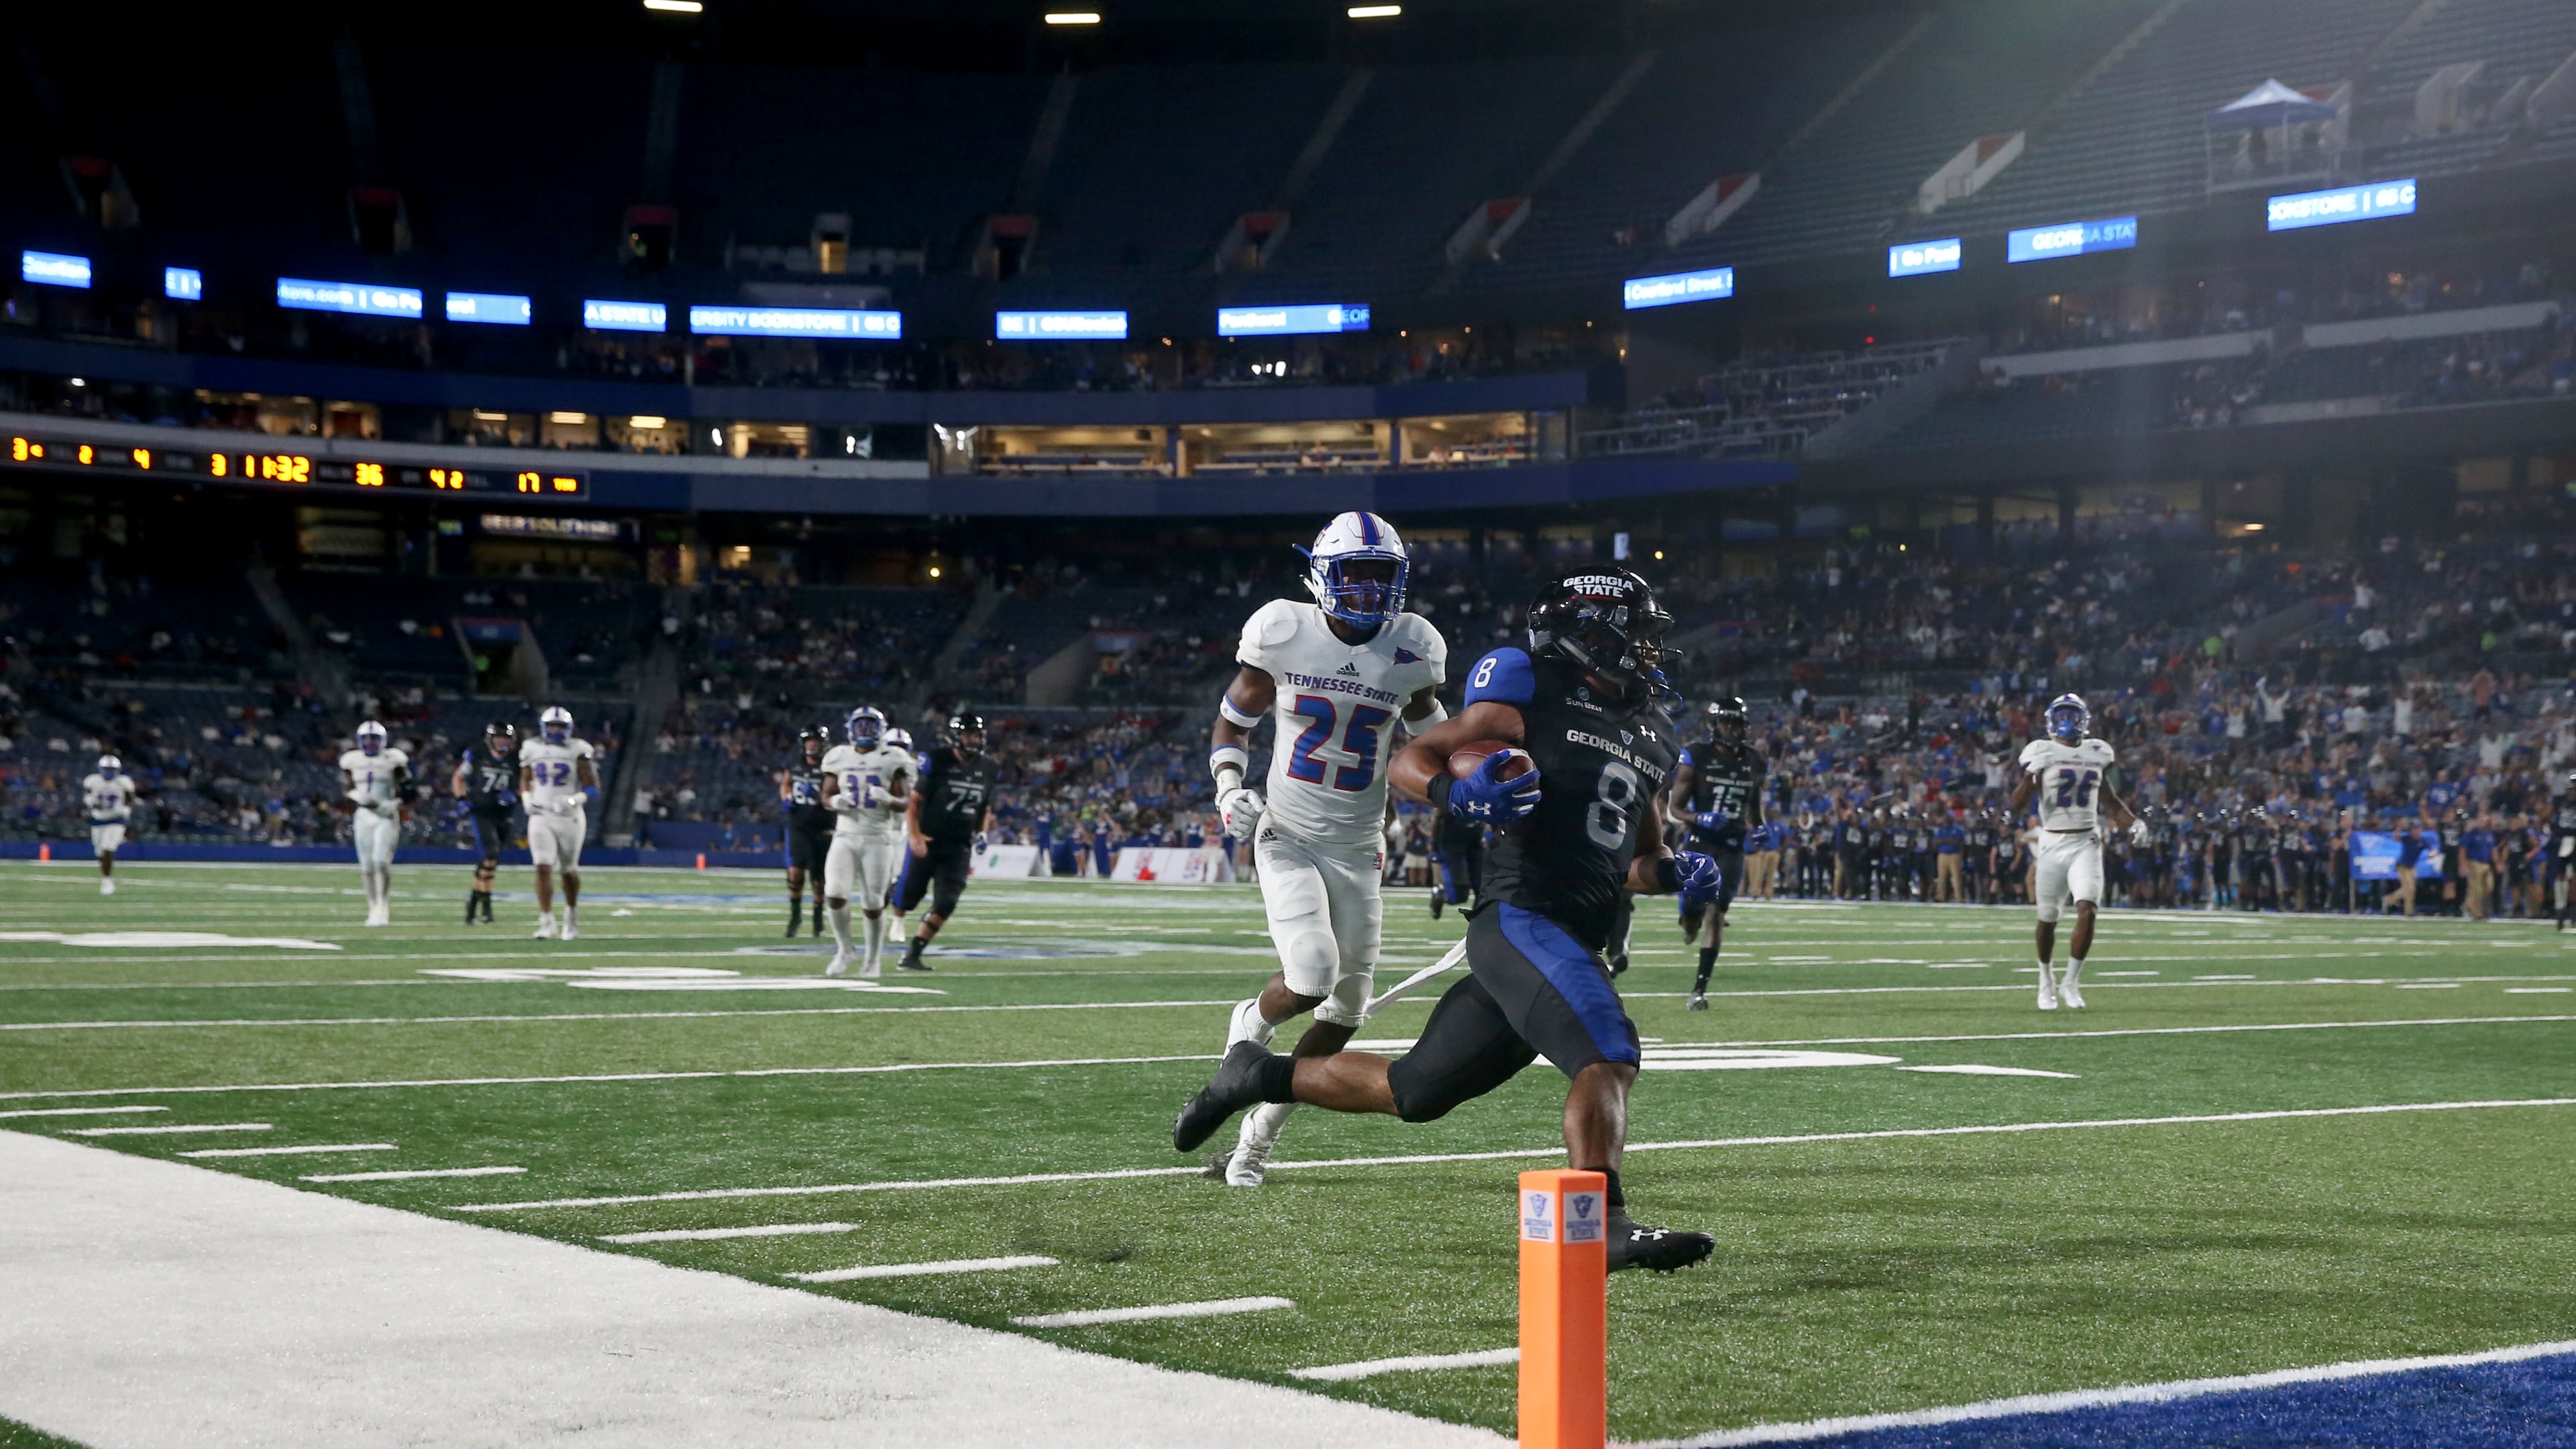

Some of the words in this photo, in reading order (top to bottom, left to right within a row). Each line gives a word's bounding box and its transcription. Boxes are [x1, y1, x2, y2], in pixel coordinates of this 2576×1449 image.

[134, 449, 150, 469] 4
[211, 453, 227, 477] 3
[1563, 575, 1634, 592] GEORGIA
[1574, 585, 1623, 598] STATE
[1285, 672, 1364, 696] TENNESSEE
[1364, 687, 1399, 704] STATE
[1474, 657, 1497, 688] 8
[1287, 694, 1392, 792] 25
[1566, 729, 1631, 763] GEORGIA
[1633, 755, 1665, 784] STATE
[1587, 761, 1638, 850] 8
[1712, 785, 1746, 818] 15
